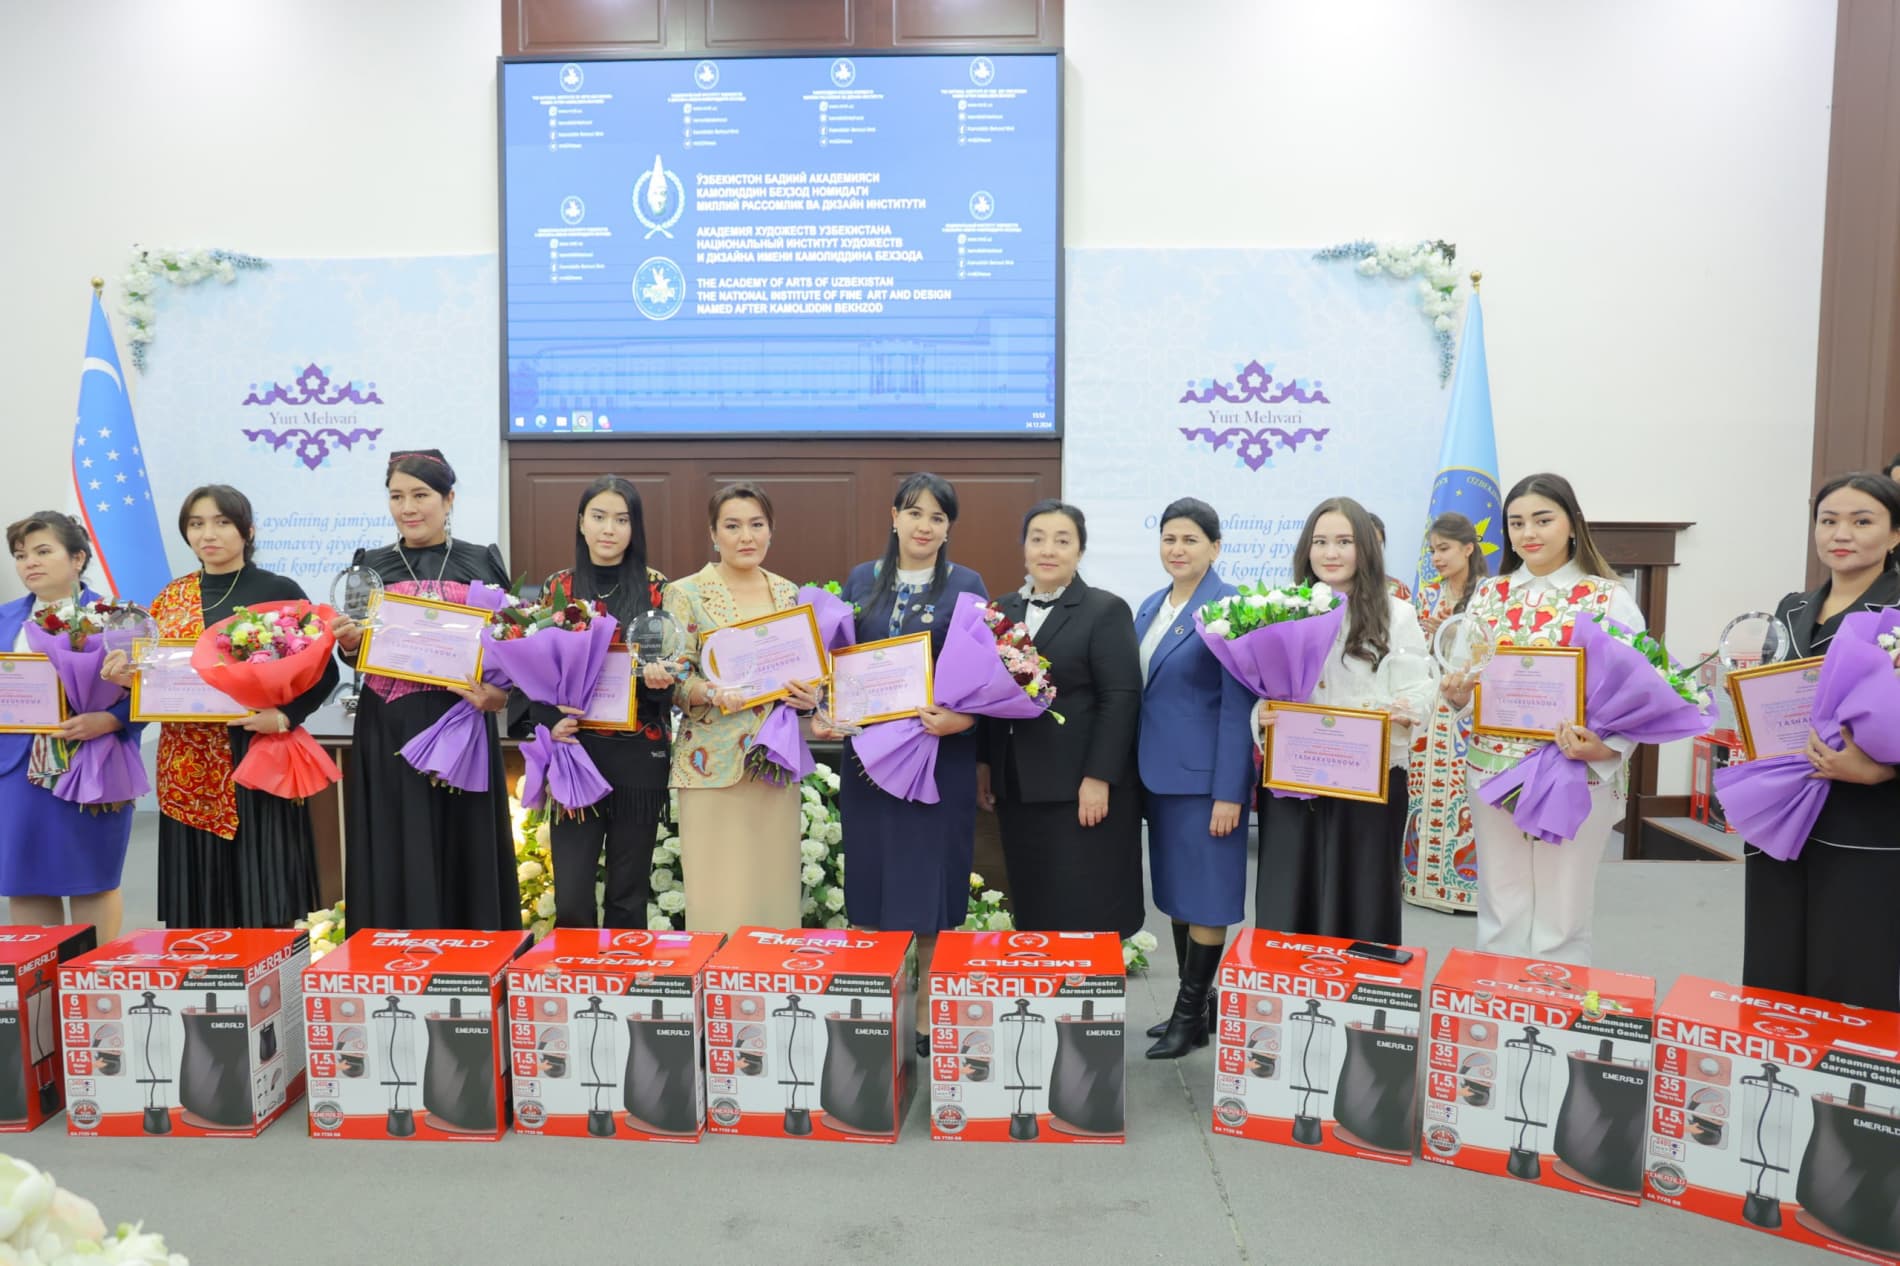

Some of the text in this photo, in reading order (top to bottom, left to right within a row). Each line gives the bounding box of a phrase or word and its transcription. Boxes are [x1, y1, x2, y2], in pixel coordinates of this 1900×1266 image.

[809, 172, 880, 184] АКАДЕМИЯСИ
[696, 187, 766, 199] КАМОЛИДДИН
[812, 186, 869, 198] НОМИДАГИ
[696, 198, 927, 211] МИЛЛИЙ РАССОМЛИК ВА ДИЗАЙН ИНСТИТУТИ
[696, 225, 892, 238] АКАДЕМИЯ ХУДОЖЕСТВ УЗБЕКИСТАНА
[697, 237, 904, 250] НАЦИОНАЛЬНЫЙ ИНСТИТУТ ХУДОЖЕСТВ
[697, 250, 923, 264] И ДИЗАЙНА ИМЕНИ КАМОЛИДДИНА БЕХЗОДА
[696, 276, 894, 288] THE ACADEMY OF ARTS OF UZBEKISTAN
[696, 289, 952, 302] THE NATIONAL INSTITUTE OF FINE ART AND DESIGN
[697, 302, 883, 314] NAMED AFTER KAMOLIDDIN BEKHZOD
[269, 410, 357, 426] Yurt Mehvari
[1208, 409, 1302, 425] Yurt Mehvari
[263, 511, 329, 533] ayolining
[1220, 513, 1272, 535] olining
[372, 938, 490, 948] EMERALD
[758, 936, 875, 949] EMERALD
[18, 950, 57, 977] EMERALD
[248, 945, 292, 982] EMERALD
[555, 956, 675, 967] EMERALD
[967, 959, 1092, 967] EMERALD
[60, 971, 178, 990] EMERALD
[304, 974, 422, 994] EMERALD
[432, 978, 483, 986] Steammaster
[508, 973, 625, 994] EMERALD
[705, 971, 823, 993] EMERALD
[834, 978, 885, 986] Steammaster
[931, 977, 1053, 997] EMERALD
[1221, 968, 1345, 1000] EMERALD
[630, 986, 663, 994] Garment
[863, 986, 890, 994] Genius
[1358, 986, 1413, 1000] Steammaster
[70, 995, 79, 1006] 6
[314, 998, 323, 1009] 6
[518, 996, 526, 1007] 6
[715, 995, 723, 1006] 6
[1229, 993, 1238, 1004] 6
[1352, 994, 1418, 1009] Garment Genius
[940, 1001, 949, 1012] 6
[1432, 989, 1567, 1028] EMERALD
[1710, 989, 1868, 1027] EMERALD
[712, 1022, 728, 1033] 35
[1224, 1020, 1241, 1033] 35
[1441, 1015, 1450, 1028] 6
[69, 1023, 85, 1034] 35
[312, 1026, 328, 1037] 35
[515, 1024, 531, 1035] 35
[656, 1029, 690, 1037] EMERALD
[855, 1028, 889, 1036] EMERALD
[937, 1028, 953, 1040] 35
[1086, 1029, 1121, 1037] EMERALD
[1574, 1022, 1649, 1040] Garment Genius
[1376, 1040, 1414, 1052] EMERALD
[1657, 1018, 1812, 1067] EMERALD
[1435, 1043, 1453, 1058] 35
[1666, 1046, 1676, 1059] 6
[1820, 1062, 1867, 1078] Garment
[1602, 1071, 1644, 1086] EMERALD
[1660, 1076, 1680, 1092] 35
